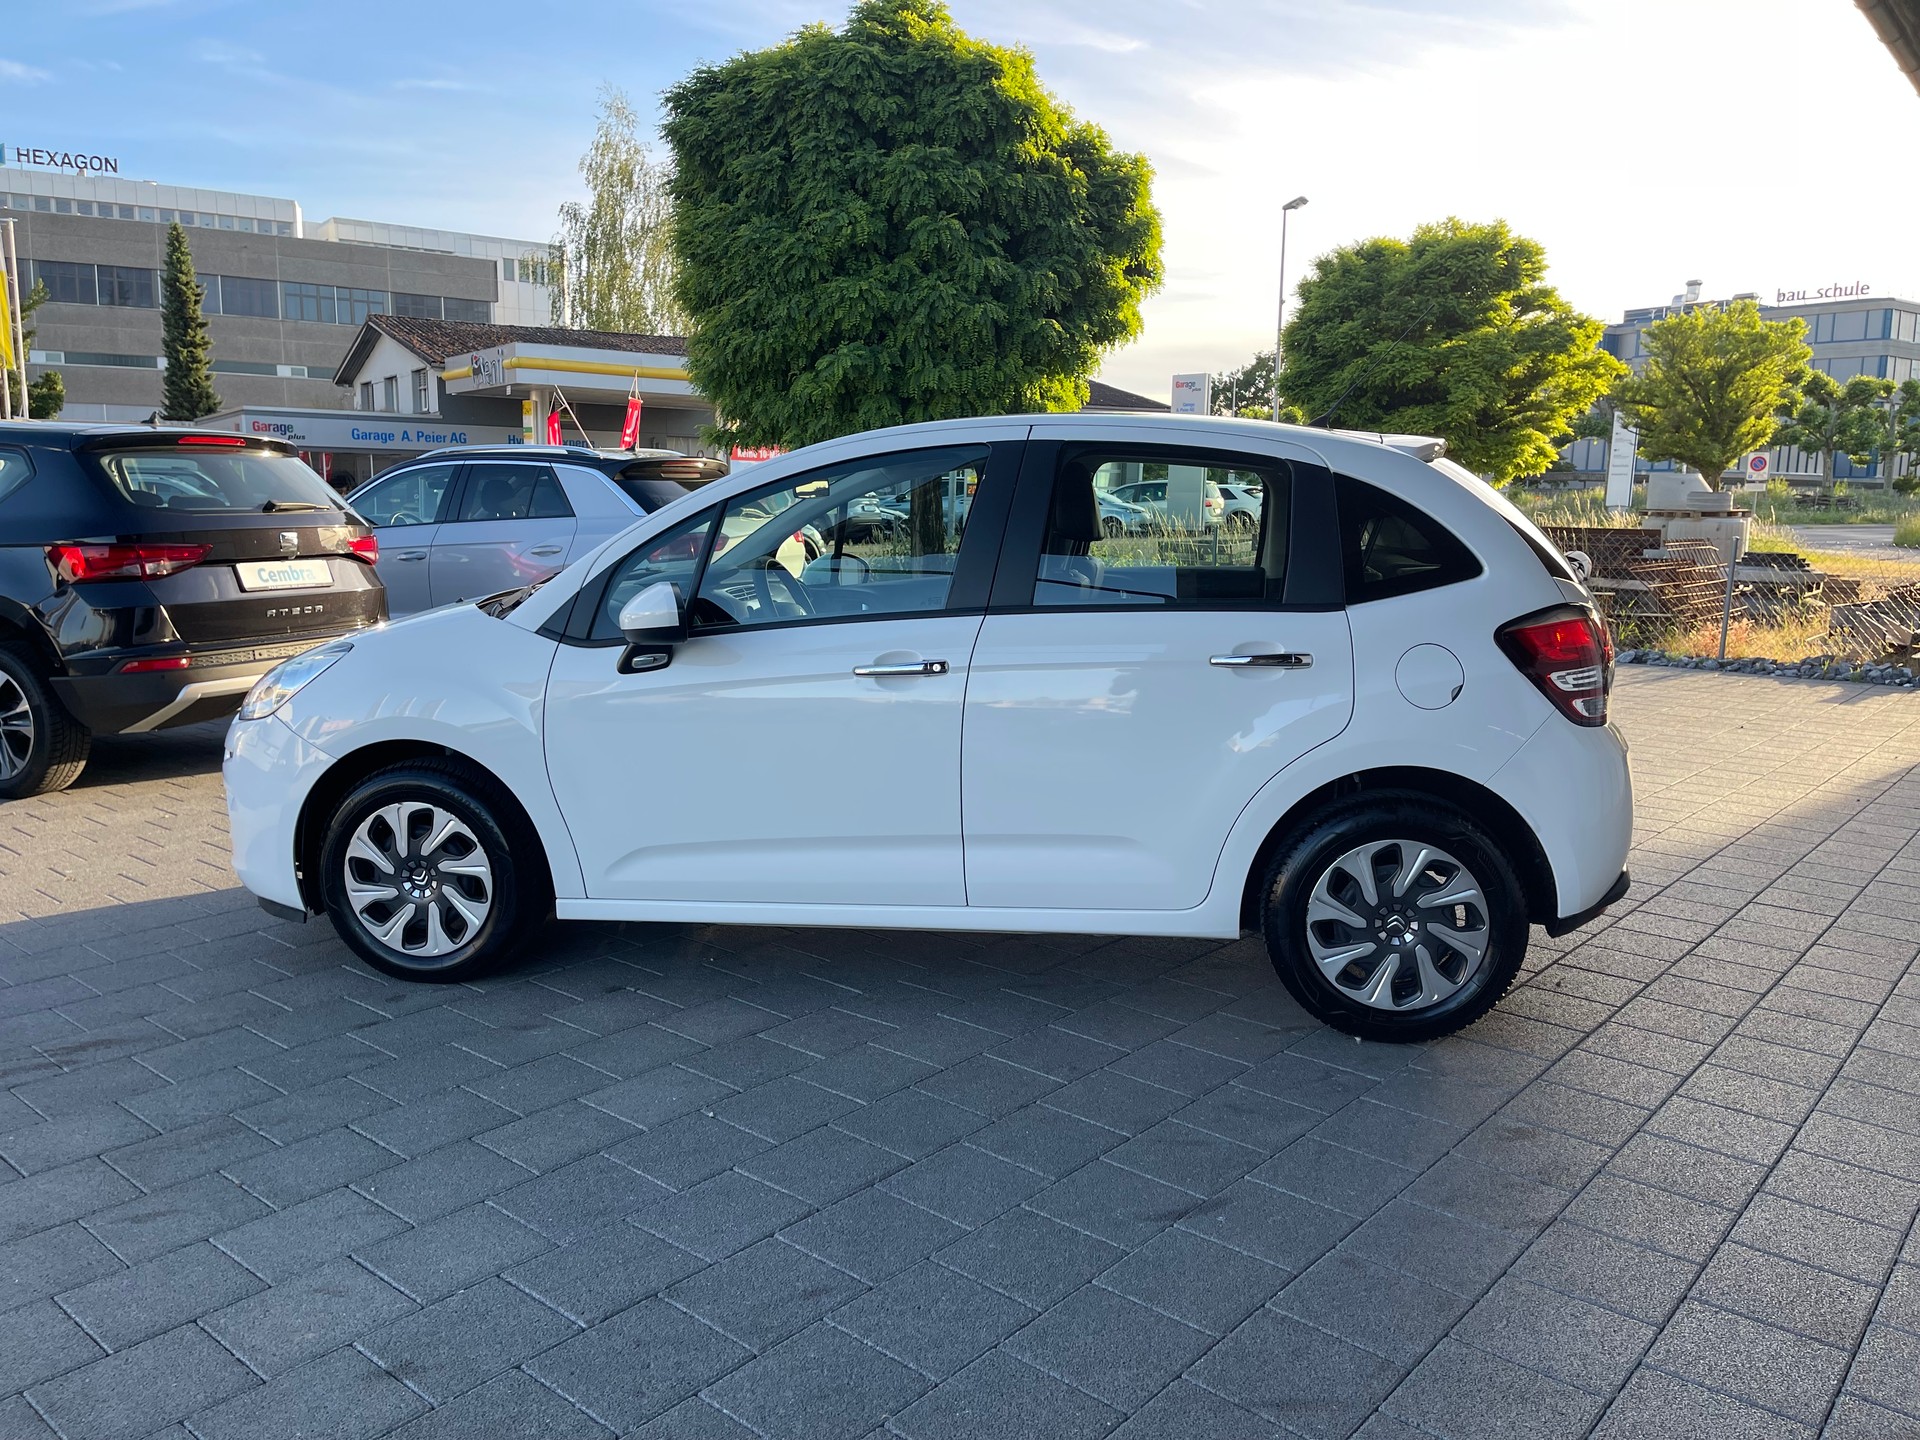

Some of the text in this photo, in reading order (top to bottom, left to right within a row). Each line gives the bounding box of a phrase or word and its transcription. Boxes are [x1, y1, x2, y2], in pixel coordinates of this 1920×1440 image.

[16, 147, 118, 173] HEXAGON
[1175, 381, 1196, 389] Garage
[252, 420, 294, 436] Garage
[351, 428, 467, 444] Garage A. Peier AG
[257, 565, 316, 582] Cembra
[266, 605, 324, 618] ATECA
